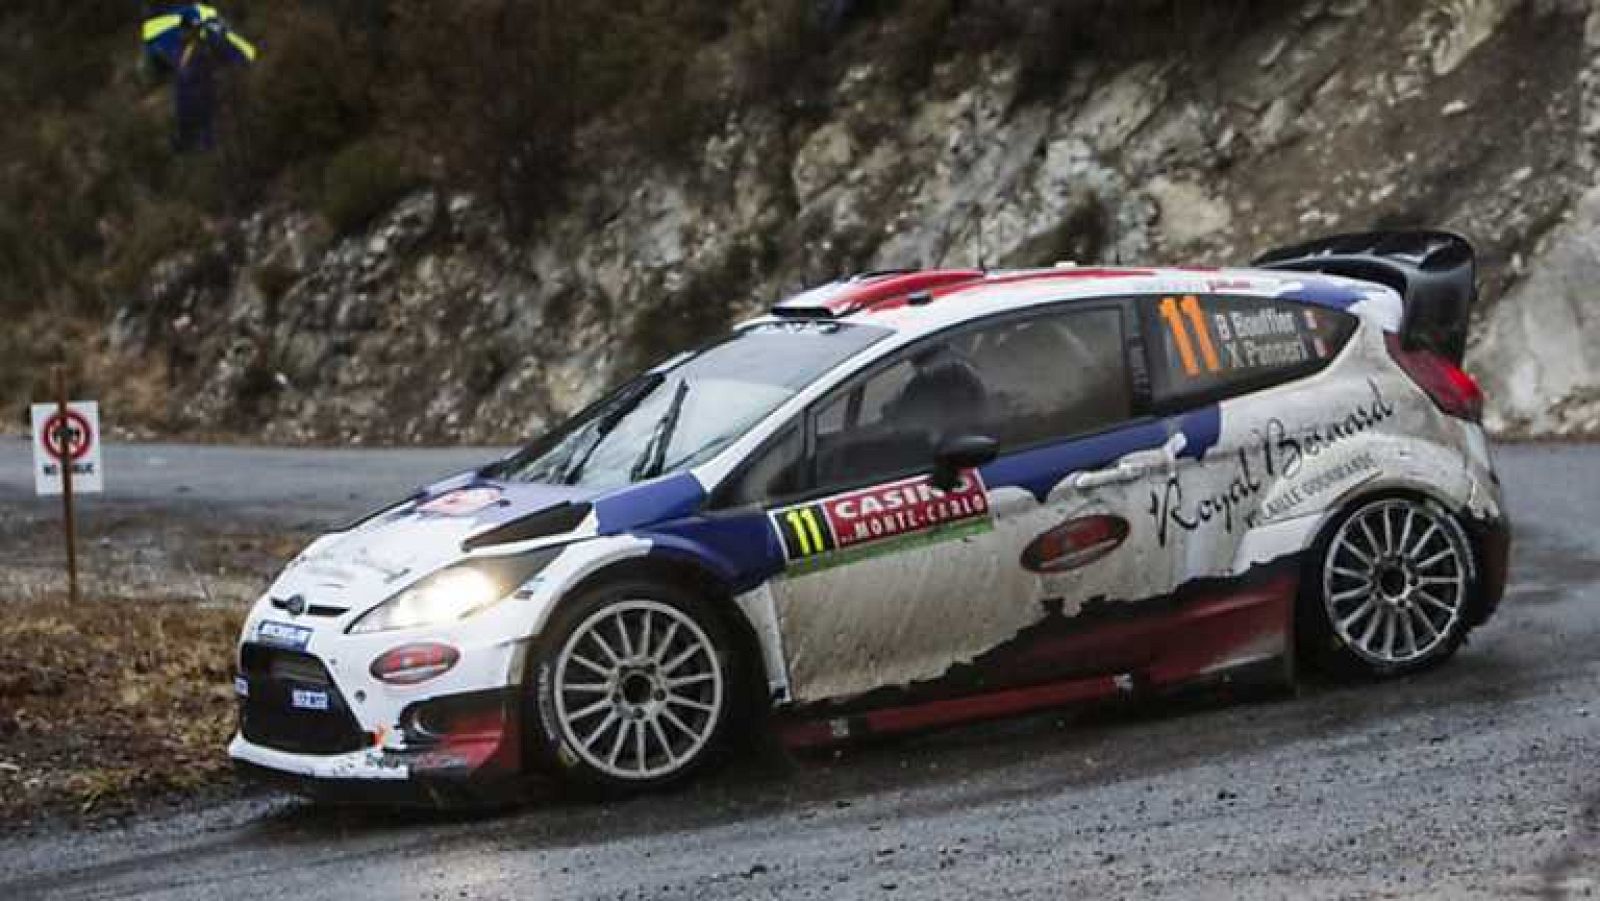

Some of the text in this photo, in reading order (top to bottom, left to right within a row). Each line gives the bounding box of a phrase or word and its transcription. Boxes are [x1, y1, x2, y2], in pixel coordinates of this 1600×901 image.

[1159, 296, 1220, 376] 11
[1148, 447, 1262, 548] Royal
[1262, 376, 1395, 479] Bernard
[786, 508, 826, 555] 11
